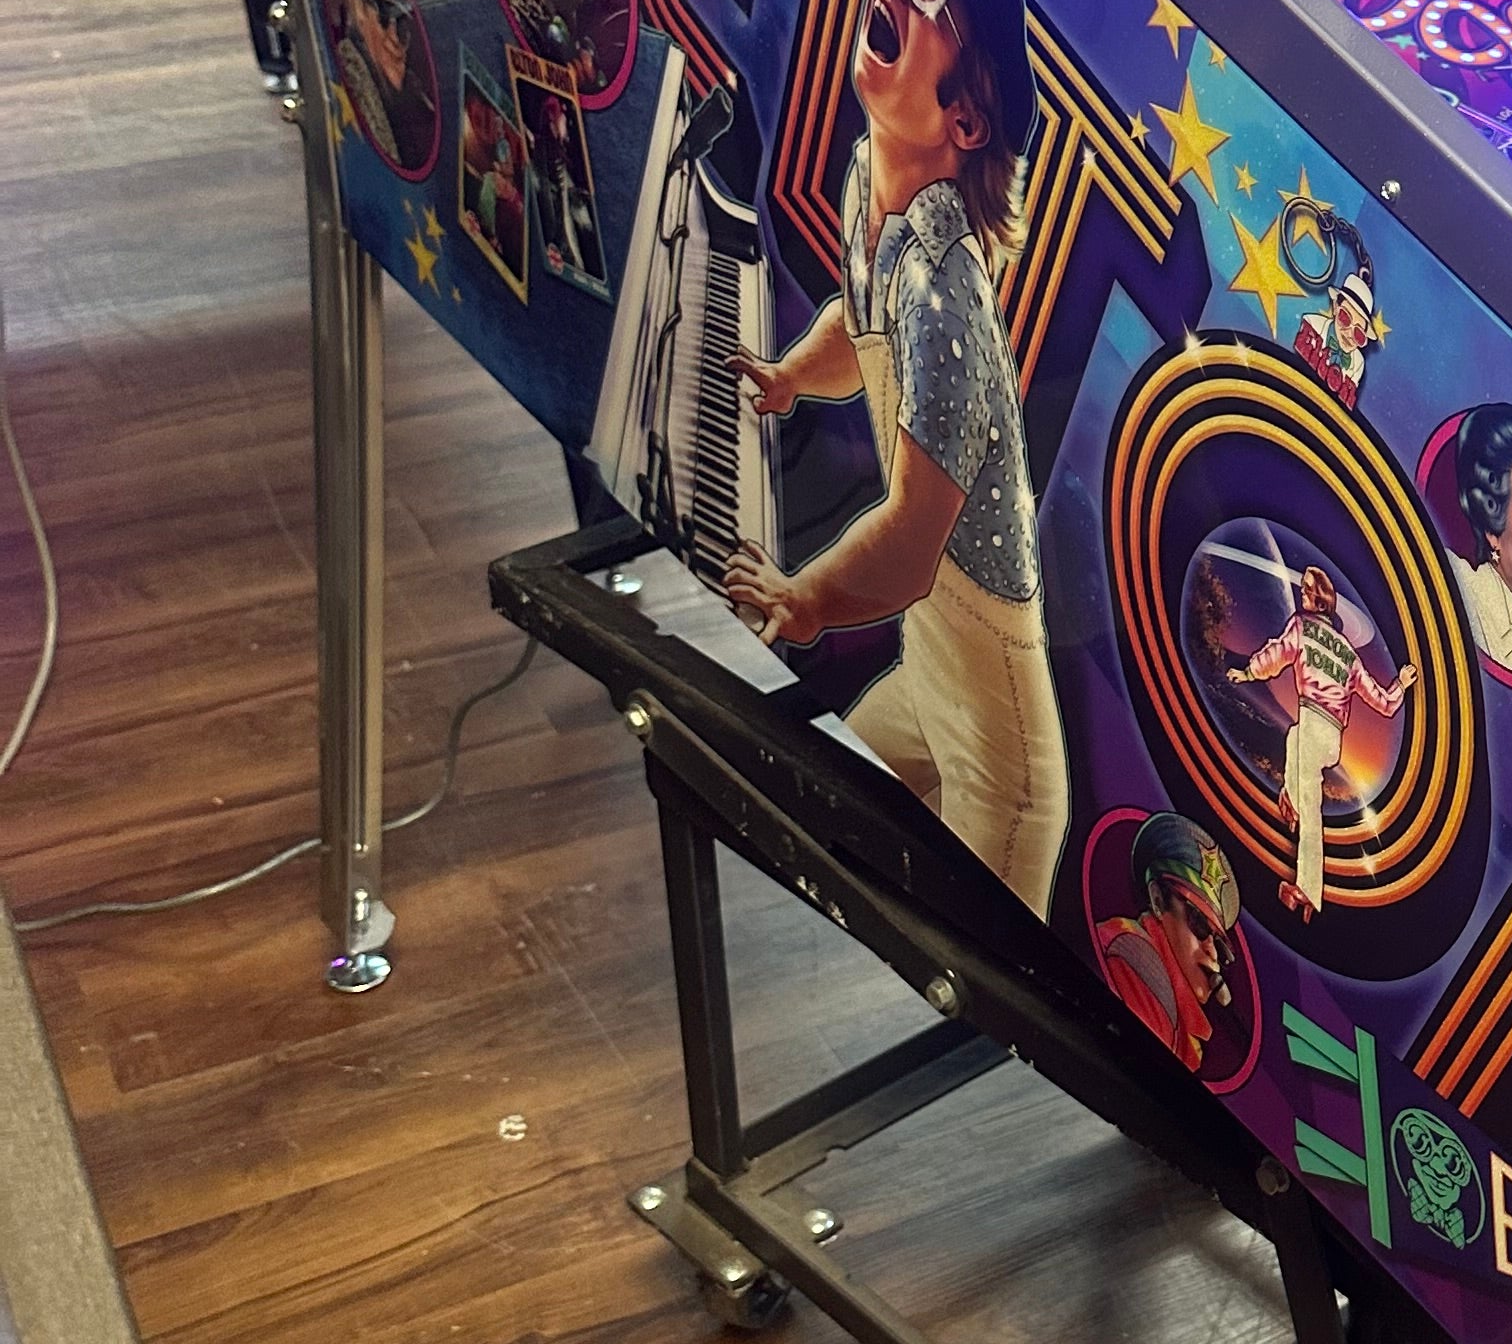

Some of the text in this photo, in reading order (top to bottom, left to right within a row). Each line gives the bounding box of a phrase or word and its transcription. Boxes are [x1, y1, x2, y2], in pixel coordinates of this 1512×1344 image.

[1293, 317, 1358, 412] Elton
[1301, 618, 1357, 670] ELTON
[1303, 643, 1350, 689] JOHN
